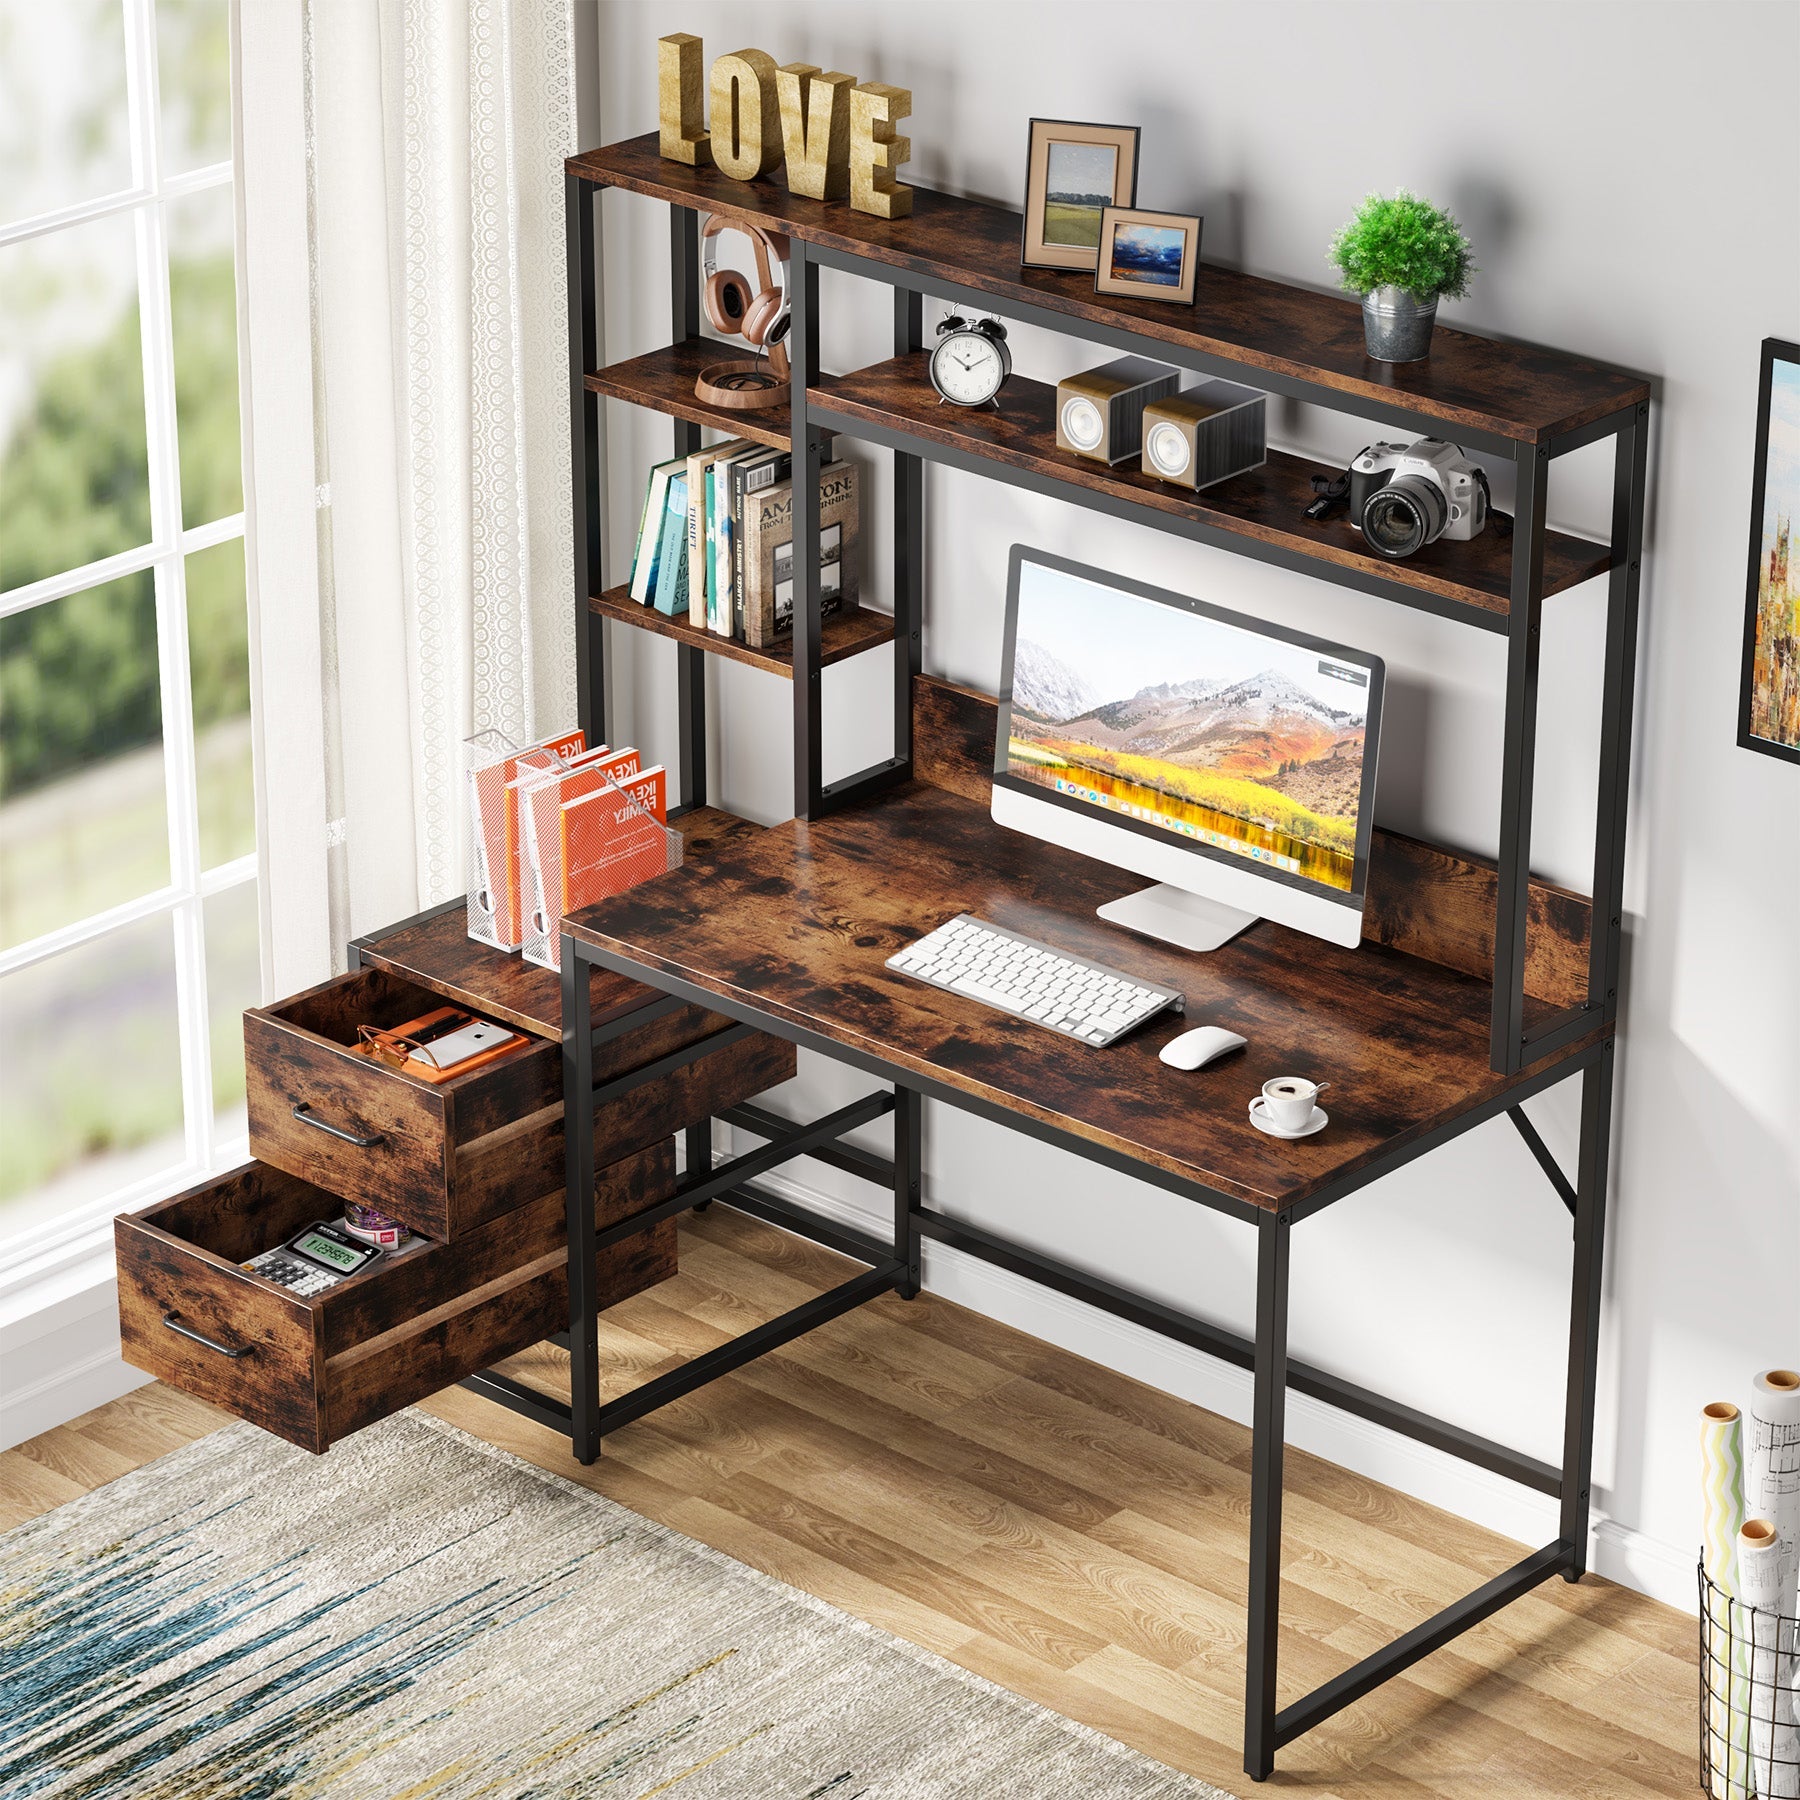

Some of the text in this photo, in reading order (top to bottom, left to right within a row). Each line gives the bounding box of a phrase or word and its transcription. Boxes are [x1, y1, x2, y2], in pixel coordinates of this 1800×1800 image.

[658, 32, 913, 219] LOVE
[689, 507, 697, 549] THRIFT
[760, 518, 784, 531] FROM
